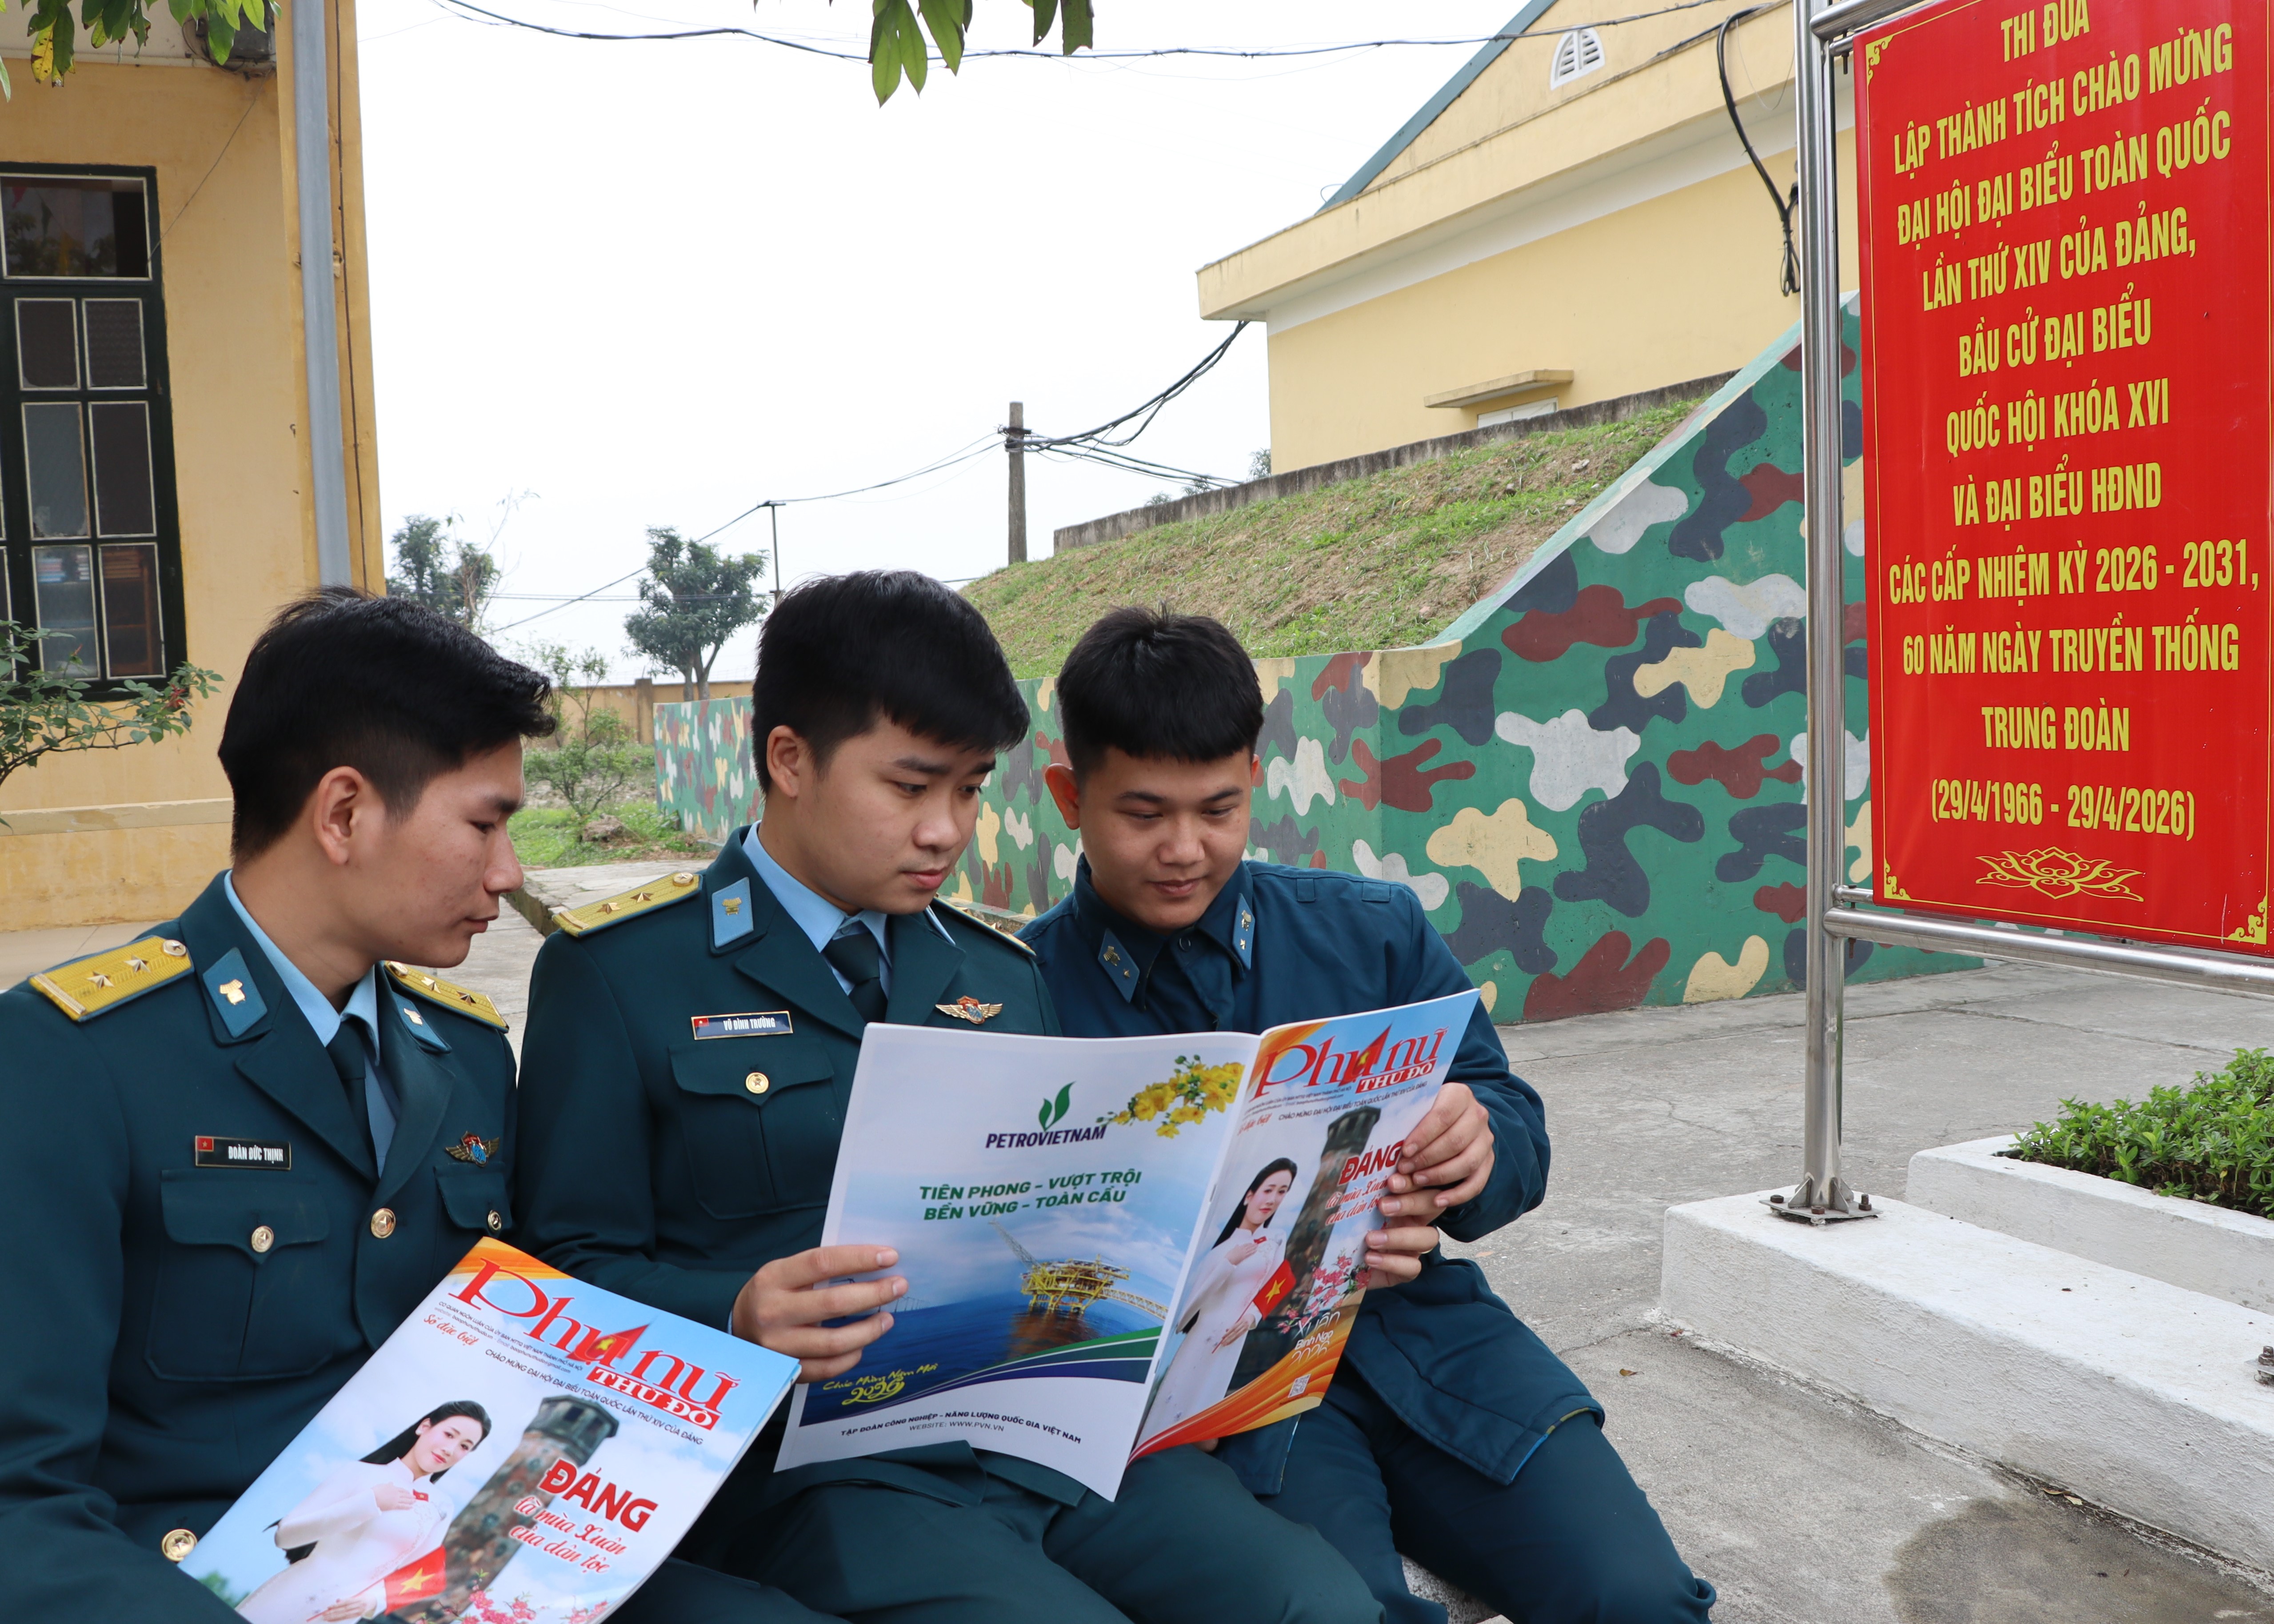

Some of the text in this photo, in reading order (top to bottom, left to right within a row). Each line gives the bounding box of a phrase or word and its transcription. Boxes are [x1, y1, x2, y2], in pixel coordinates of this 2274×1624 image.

[2000, 0, 2090, 62] THI ĐUA
[1894, 22, 2233, 179] LẬP THÀNH TÍCH CHÀO MỪNG
[1897, 96, 2230, 250] ĐẠI HỘI ĐẠI BIỂU TOÀN QUỐC
[1922, 200, 2195, 311] LẦN THỨ XIV CỦA ĐẢNG,
[1958, 281, 2151, 377] BẦU CỬ ĐẠI BIỂU
[1946, 377, 2169, 458] QUỐC HỘI KHÓA XVI
[1953, 453, 2161, 531] VÀ ĐẠI BIỂU HĐND
[1889, 538, 2258, 607] CÁC CẤP NHIỆM KỲ 2026 - 2031,
[1903, 607, 2239, 675] 60 NĂM NGÀY TRUYỀN THỐNG
[1981, 697, 2129, 751] TRUNG ĐOÀN
[1931, 778, 2194, 841] (29/4/1966 - 29/4/2026)
[733, 1017, 749, 1030] ĐÌNH
[749, 1015, 776, 1029] TRƯỜNG
[1379, 1025, 1449, 1074] nữ
[1405, 1061, 1433, 1080] ĐÔ
[228, 1143, 284, 1164] ĐOÀN ĐỨC THỊNH
[985, 1125, 1107, 1149] PETROVIETNAM
[919, 1184, 964, 1200] TIÊN
[967, 1181, 1031, 1199] PHONG
[1048, 1173, 1096, 1190] VƯỢT
[1100, 1168, 1142, 1187] TRỘI
[923, 1202, 963, 1221] BỀN
[969, 1201, 1018, 1218] VỮNG
[1035, 1191, 1085, 1209] TOÀN
[1087, 1185, 1127, 1203] CẦU
[1347, 1200, 1367, 1218] dân
[448, 1257, 742, 1415] Phụ nữ
[1290, 1340, 1330, 1367] 2026
[485, 1349, 506, 1362] CHÀO
[505, 1358, 528, 1372] MỪNG
[527, 1368, 540, 1377] ĐẠI
[540, 1372, 553, 1383] HỘI
[553, 1378, 566, 1388] ĐẠI
[580, 1388, 601, 1400] TOÀN
[600, 1396, 623, 1409] QUỐC
[651, 1418, 665, 1428] XIV
[664, 1423, 680, 1436] CỦA
[663, 1397, 713, 1427] ĐÔ
[884, 1418, 907, 1427] CÔNG
[908, 1413, 938, 1423] NGHIỆP
[1001, 1415, 1024, 1424] QUỐC
[1025, 1420, 1040, 1429] GIA
[1042, 1424, 1062, 1435] VIỆT
[1062, 1431, 1081, 1444] NAM
[949, 1421, 1004, 1432] WWW.PVN.VN
[538, 1459, 659, 1533] ĐẢNG
[509, 1525, 610, 1573] của dân tộc
[514, 1496, 627, 1556] là mùa Xuân
